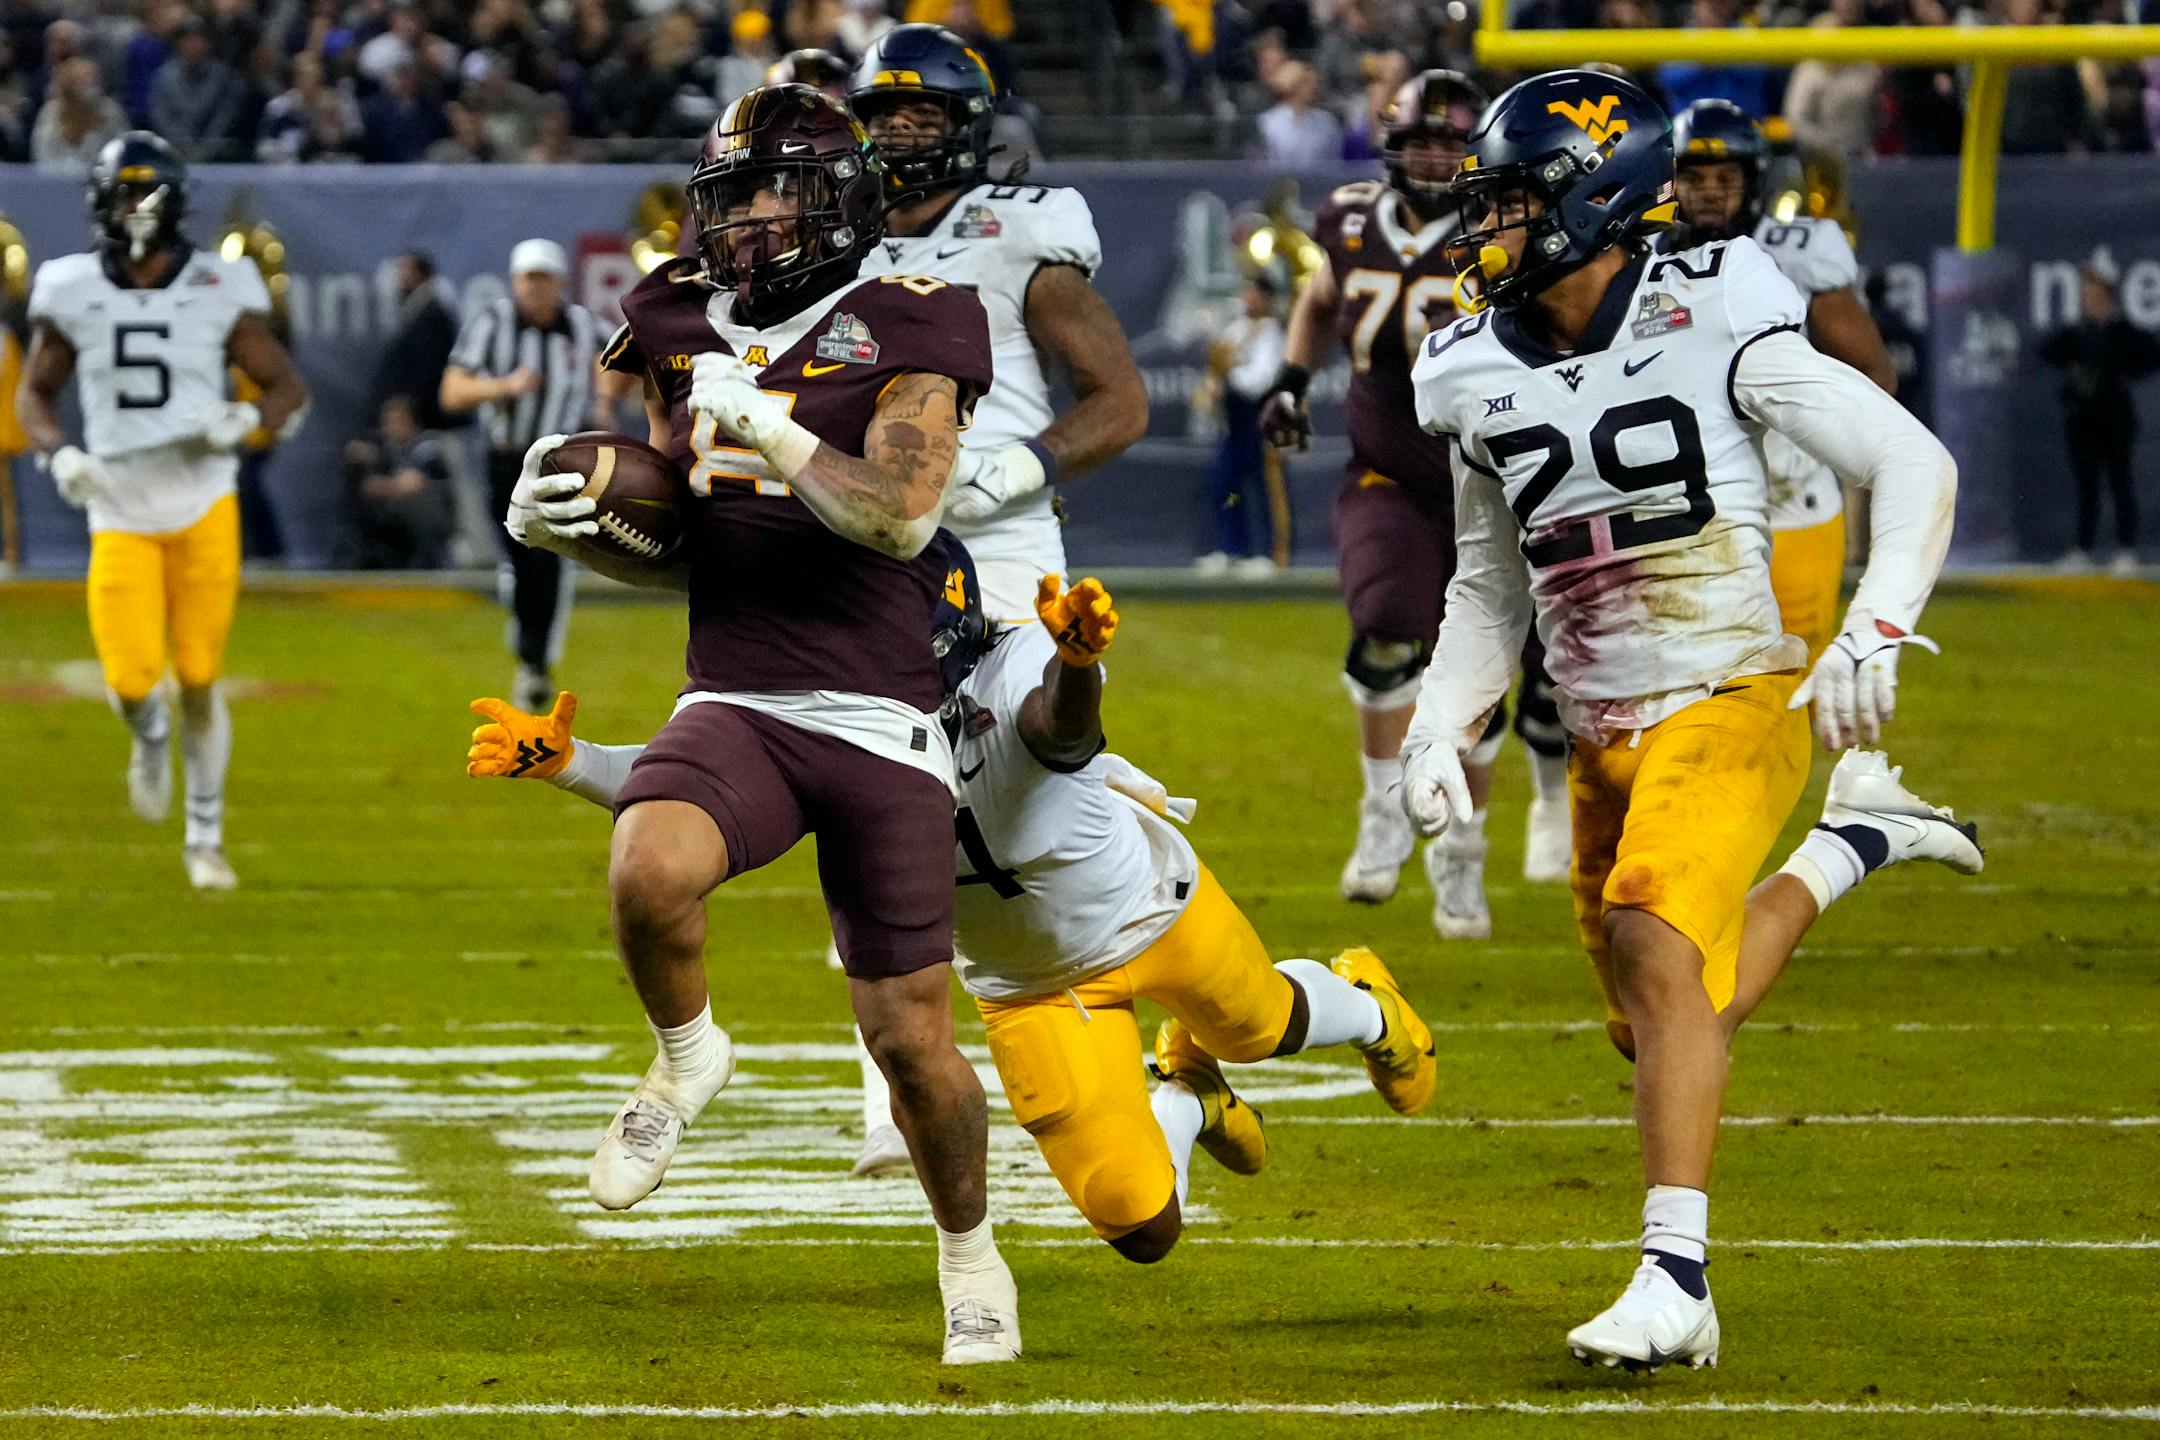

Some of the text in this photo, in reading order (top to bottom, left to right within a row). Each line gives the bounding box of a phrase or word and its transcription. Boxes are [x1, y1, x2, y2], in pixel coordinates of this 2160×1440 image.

[114, 323, 170, 409] 5
[1483, 391, 1518, 418] XII
[1482, 394, 1716, 569] 29
